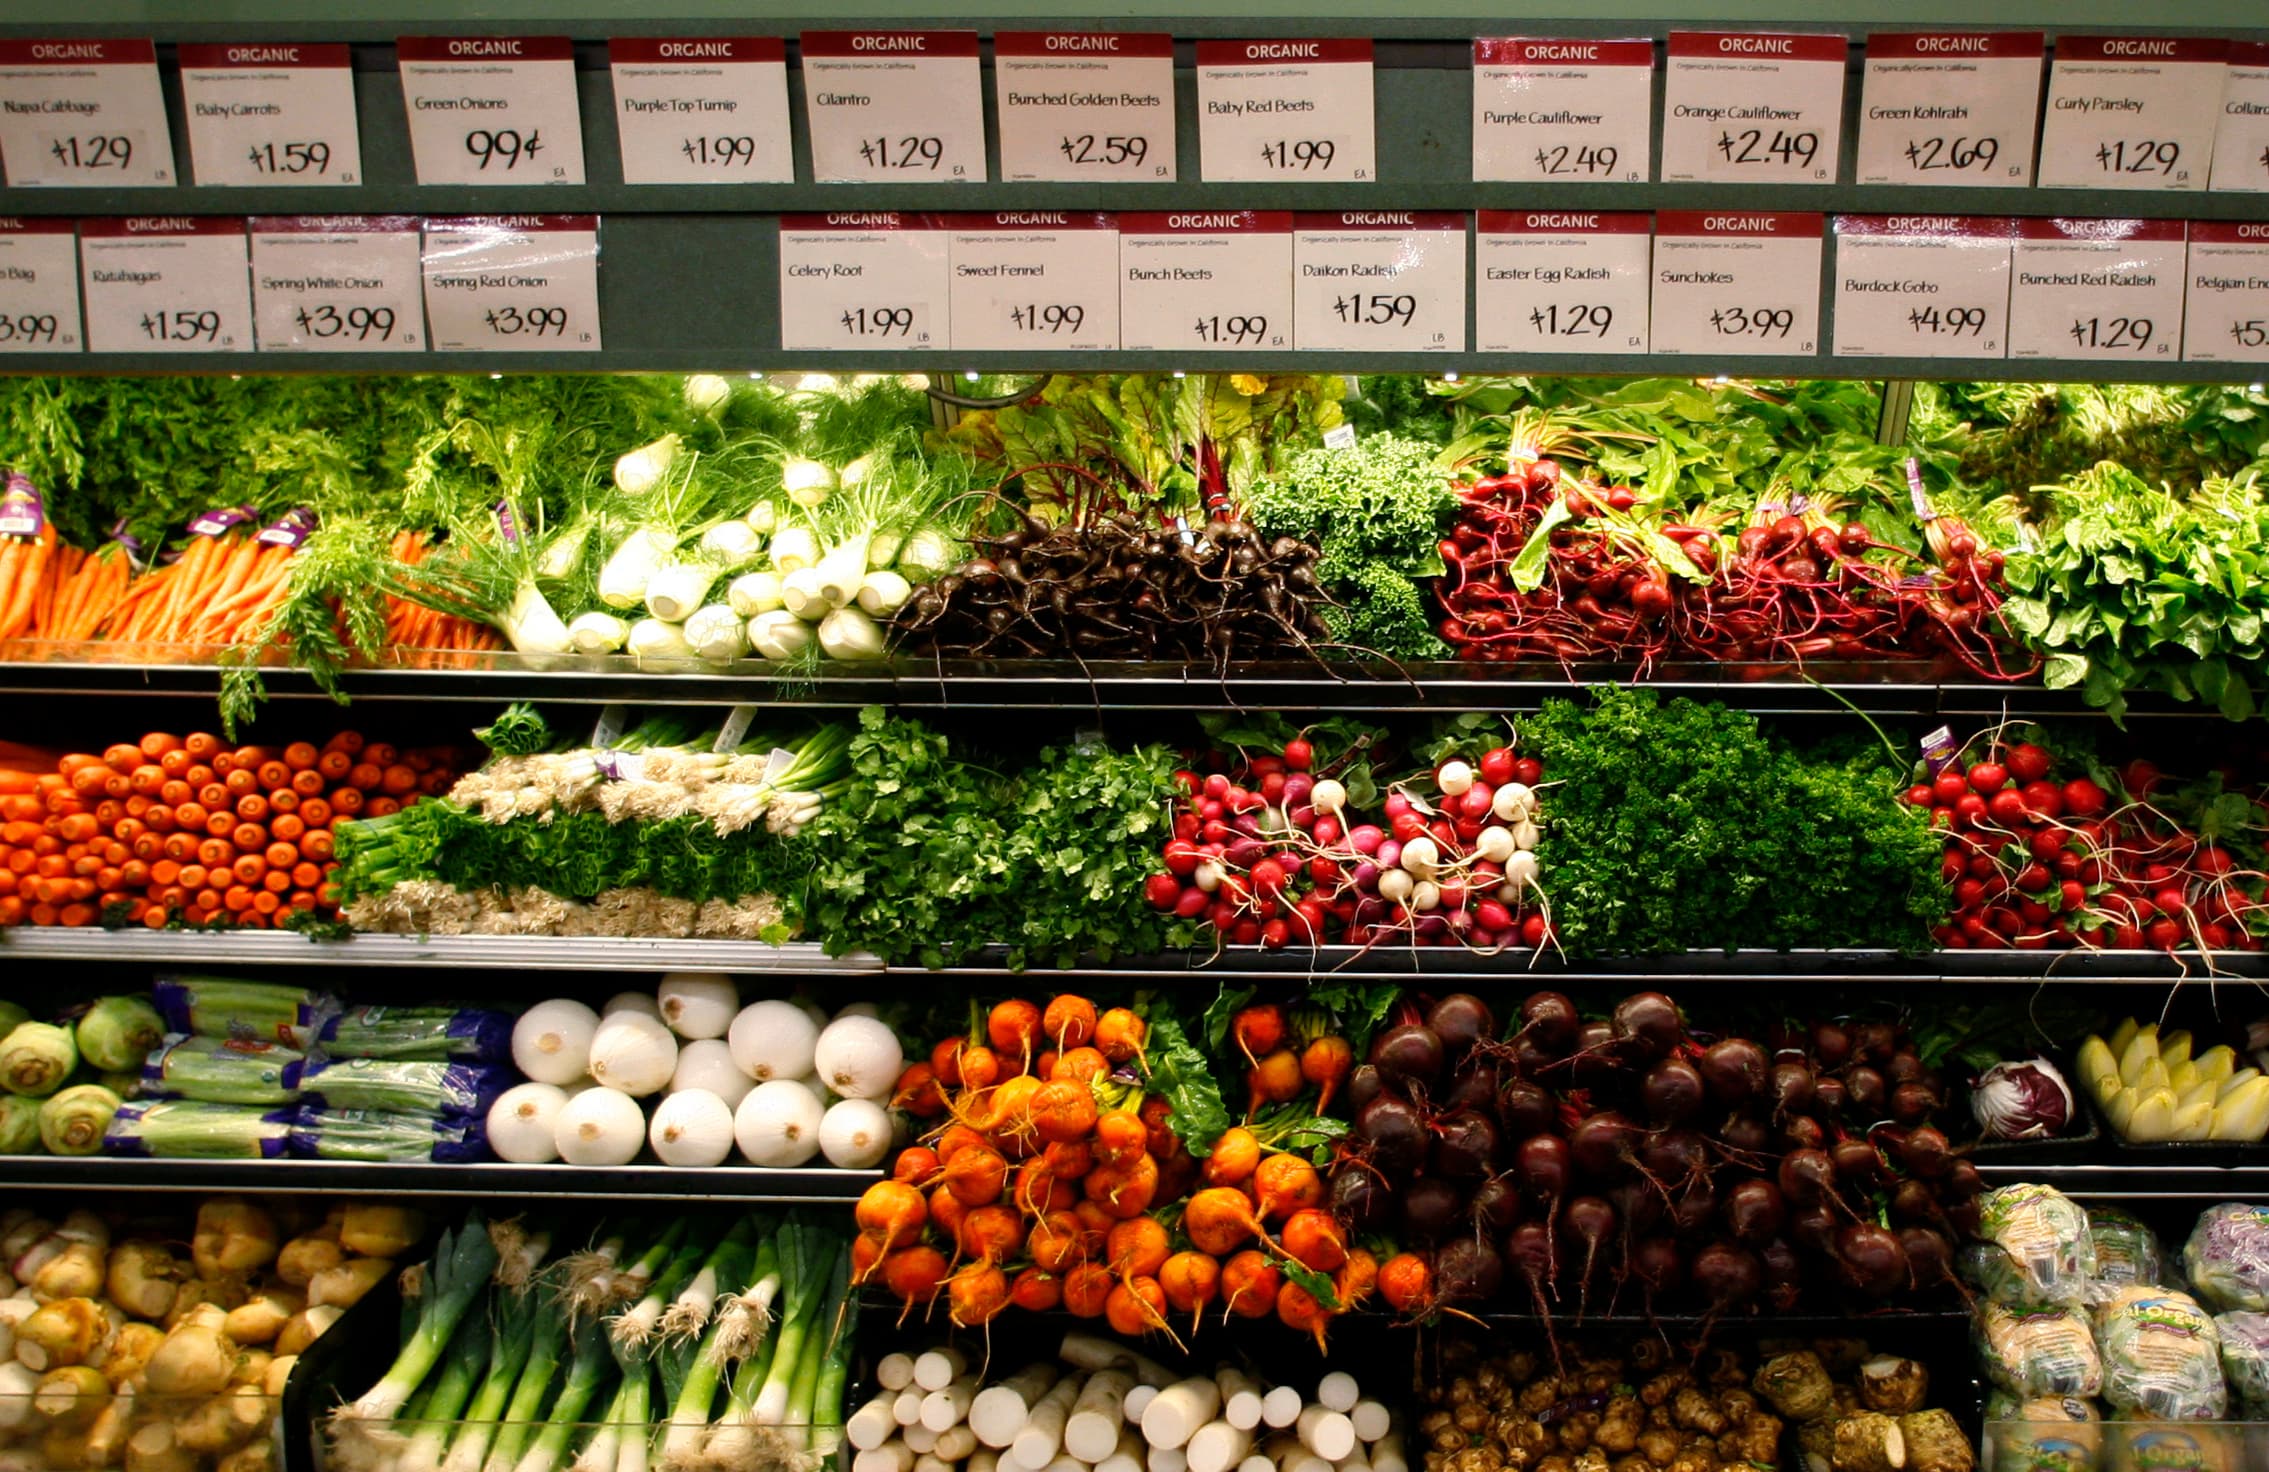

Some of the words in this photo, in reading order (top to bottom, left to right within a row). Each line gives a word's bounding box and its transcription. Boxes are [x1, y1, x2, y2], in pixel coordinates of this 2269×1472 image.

[32, 44, 104, 58] ORGANIC
[449, 41, 522, 55] ORGANIC
[660, 43, 732, 56] ORGANIC
[852, 37, 925, 51] ORGANIC
[1046, 37, 1119, 51] ORGANIC
[1720, 39, 1792, 53] ORGANIC
[1916, 38, 1989, 51] ORGANIC
[2104, 42, 2176, 55] ORGANIC
[228, 48, 299, 62] ORGANIC
[1246, 44, 1319, 59] ORGANIC
[1525, 47, 1598, 60] ORGANIC
[415, 97, 459, 110] Green
[460, 97, 507, 110] Onions
[625, 100, 668, 113] Purple
[670, 100, 694, 113] Top
[694, 100, 736, 112] Turnip
[817, 93, 870, 106] Cilantro
[1009, 93, 1067, 105] Bunched
[1069, 93, 1118, 106] Golden
[1121, 94, 1160, 106] Beets
[2055, 98, 2090, 112] Curly
[2093, 98, 2143, 114] Parsley
[5, 101, 41, 114] Napa
[43, 101, 100, 115] Cabbage
[196, 103, 230, 118] Baby
[231, 104, 280, 116] Carrots
[1208, 100, 1243, 115] Baby
[1246, 100, 1272, 113] Red
[1276, 100, 1314, 112] Beets
[1674, 105, 1726, 119] Orange
[1728, 106, 1802, 120] Cauliflower
[1870, 106, 1911, 119] Green
[1914, 106, 1968, 119] Kohlrabi
[1484, 112, 1527, 125] Purple
[1529, 112, 1602, 124] Cauliflower
[52, 136, 132, 168] $1.29
[466, 129, 543, 169] 99¢
[682, 136, 755, 165] $1.99
[860, 137, 943, 170] $1.29
[1061, 135, 1147, 166] $2.59
[1262, 140, 1335, 169] $1.99
[1718, 130, 1818, 168] $2.49
[1905, 137, 1999, 171] $2.69
[248, 142, 329, 173] $1.59
[1535, 146, 1617, 176] $2.49
[2096, 141, 2179, 176] $1.29
[127, 217, 196, 231] ORGANIC
[827, 213, 897, 225] ORGANIC
[997, 213, 1067, 225] ORGANIC
[1168, 215, 1240, 228] ORGANIC
[1342, 212, 1414, 225] ORGANIC
[1527, 215, 1598, 228] ORGANIC
[1704, 217, 1775, 231] ORGANIC
[1888, 218, 1959, 230] ORGANIC
[2238, 224, 2269, 237] ORG
[10, 269, 34, 281] Bag
[93, 270, 161, 285] Rutabagas
[789, 265, 830, 279] Celery
[833, 265, 862, 276] Root
[957, 265, 999, 276] Sweet
[1001, 265, 1043, 276] Fennel
[1130, 268, 1170, 280] Bunch
[1173, 268, 1212, 280] Beets
[1303, 265, 1348, 276] Daikon
[1351, 265, 1398, 277] Radish
[1487, 268, 1529, 280] Easter
[1535, 268, 1561, 282] Egg
[1564, 268, 1610, 280] Radish
[1661, 271, 1733, 283] Sunchokes
[262, 277, 304, 291] Spring
[307, 277, 343, 289] White
[344, 277, 383, 289] Onion
[433, 275, 477, 290] Spring
[480, 276, 505, 287] Red
[508, 276, 547, 287] Onion
[2020, 272, 2078, 286] Bunched
[2082, 274, 2107, 285] Red
[2111, 274, 2155, 286] Radish
[2196, 276, 2245, 292] Belgian
[1846, 280, 1901, 292] Burdock
[1903, 281, 1938, 294] Gobo
[1334, 294, 1416, 327] $1.59
[296, 306, 395, 341] $3.99
[485, 307, 567, 336] $3.99
[841, 308, 913, 336] $1.99
[1011, 305, 1084, 333] $1.99
[1530, 305, 1612, 337] $1.29
[1710, 309, 1793, 338] $3.99
[1908, 307, 1986, 336] $4.99
[140, 312, 220, 341] $1.59
[1195, 316, 1267, 344] $1.99
[2070, 318, 2153, 351] $1.29
